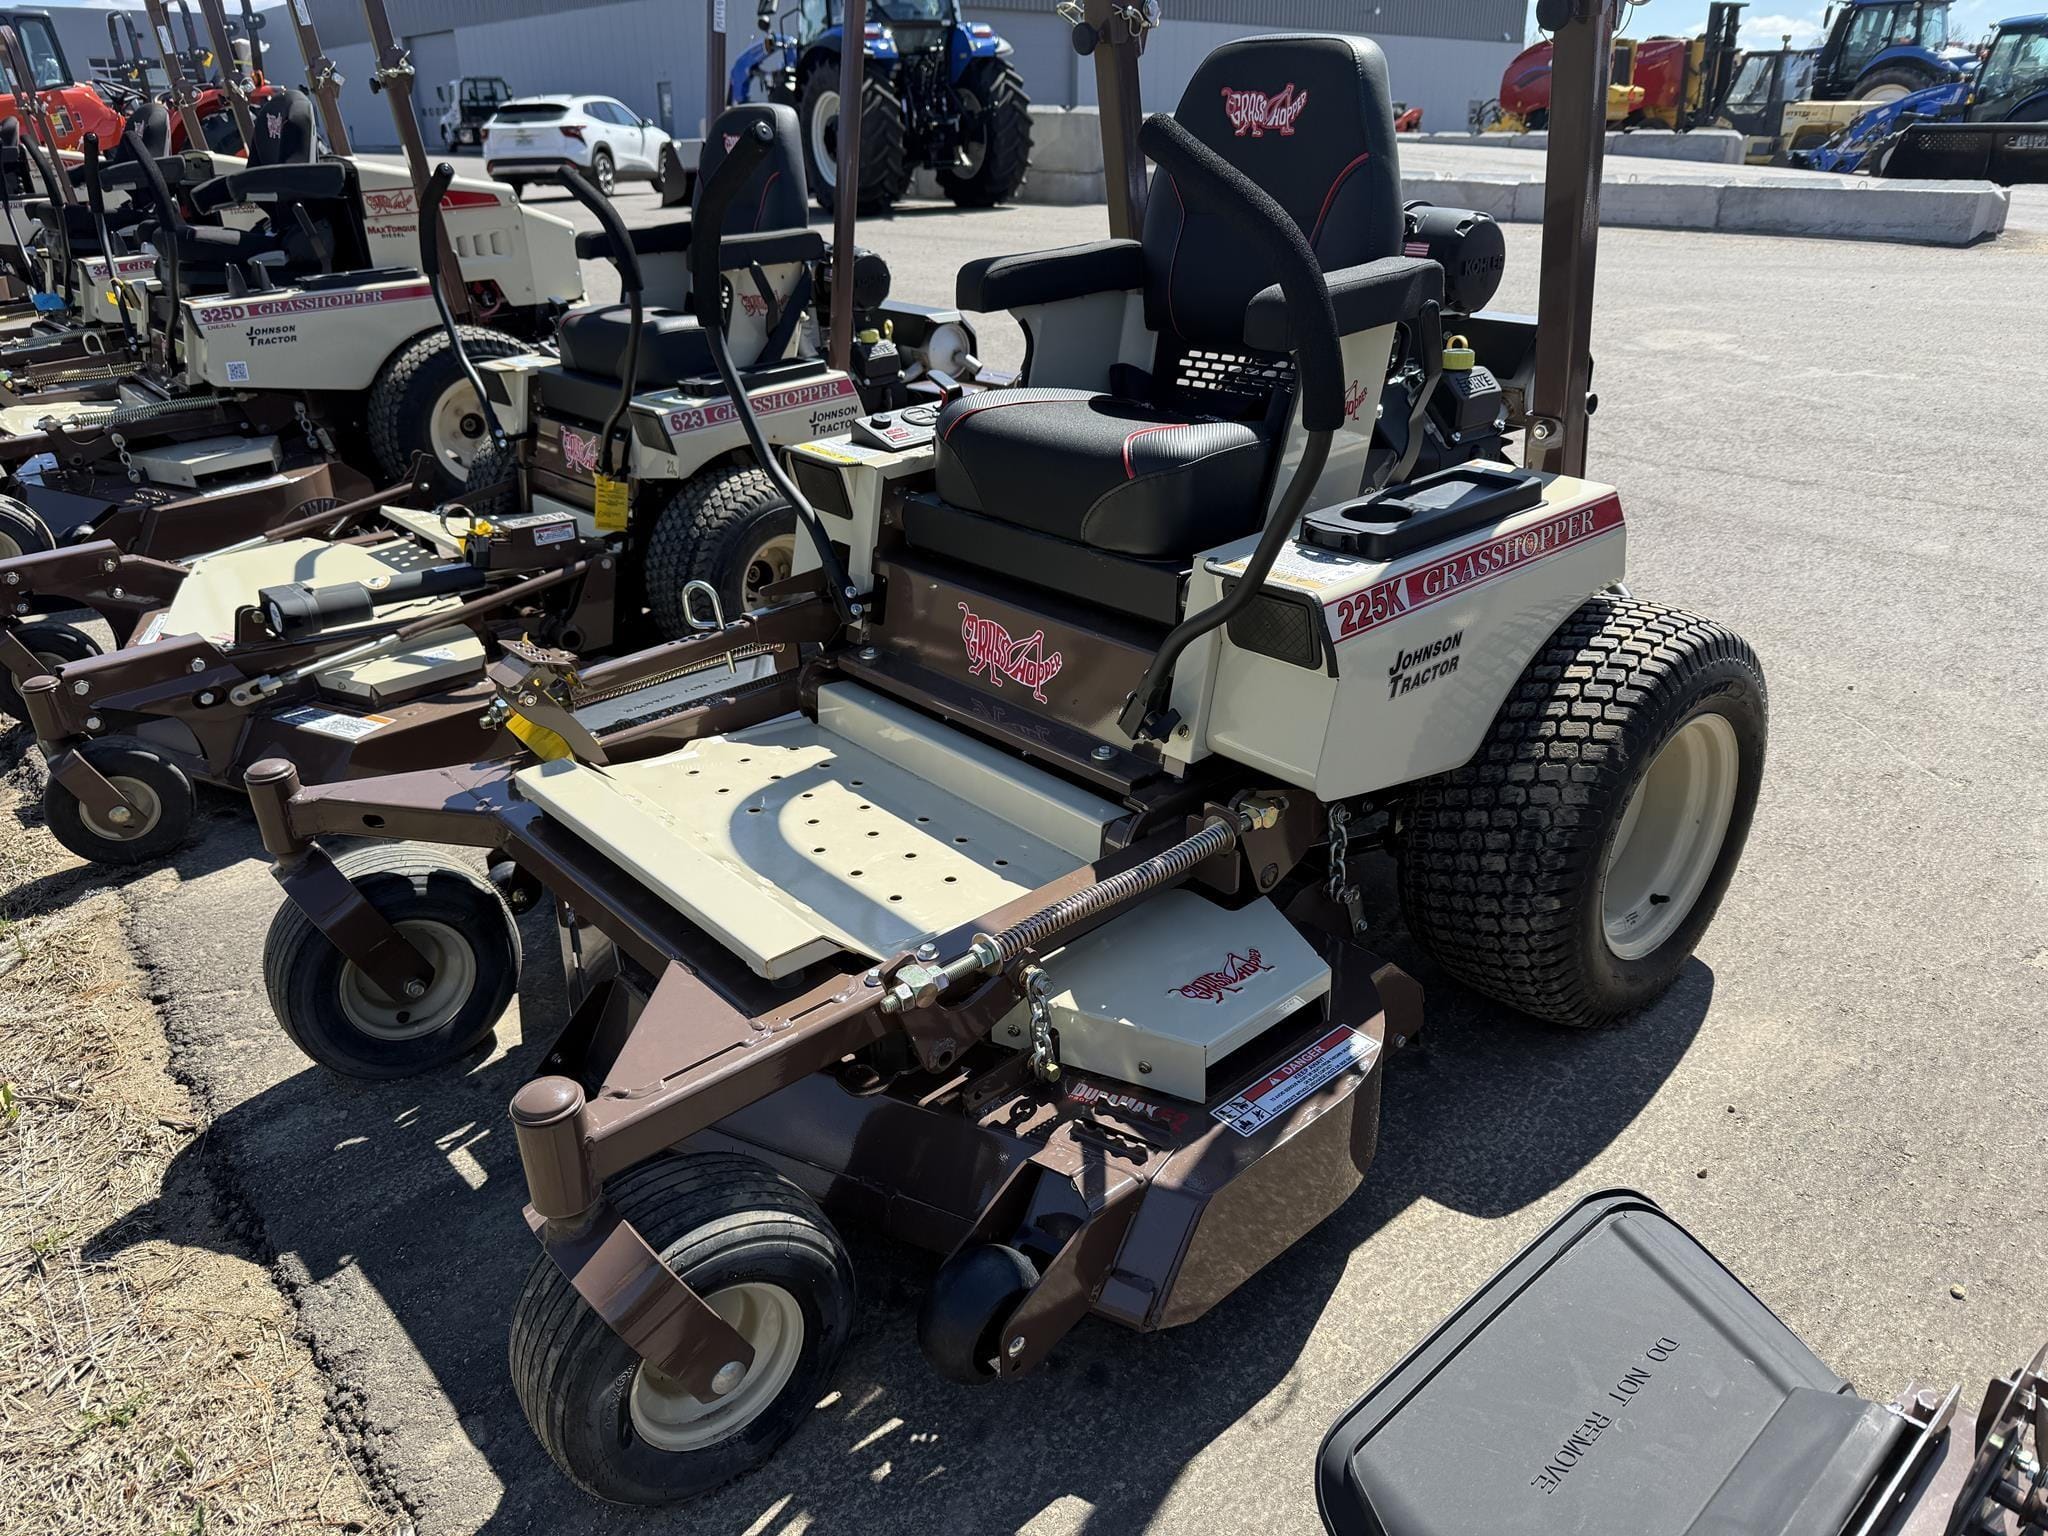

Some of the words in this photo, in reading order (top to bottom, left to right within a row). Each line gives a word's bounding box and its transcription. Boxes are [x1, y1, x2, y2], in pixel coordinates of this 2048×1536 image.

[201, 305, 244, 323] 325D
[258, 290, 383, 315] GRASSHOPPER
[246, 325, 296, 337] JOHNSON
[248, 334, 297, 347] TRACTOR
[671, 410, 704, 431] 623
[713, 382, 840, 421] GRSSHOPPER
[809, 405, 858, 424] JOHNSON
[810, 419, 852, 436] TRACTO
[1337, 578, 1406, 636] 225K
[1422, 509, 1595, 597] GRASSHOPPER
[960, 608, 1062, 695] GRASSHOPPER
[1388, 629, 1464, 677] JOHNSON
[1388, 655, 1460, 701] TRACTOR
[1281, 1045, 1326, 1075] DANGER
[1646, 1336, 1681, 1362] DO
[1609, 1366, 1652, 1407] NOT
[1530, 1411, 1613, 1495] REMOVE
